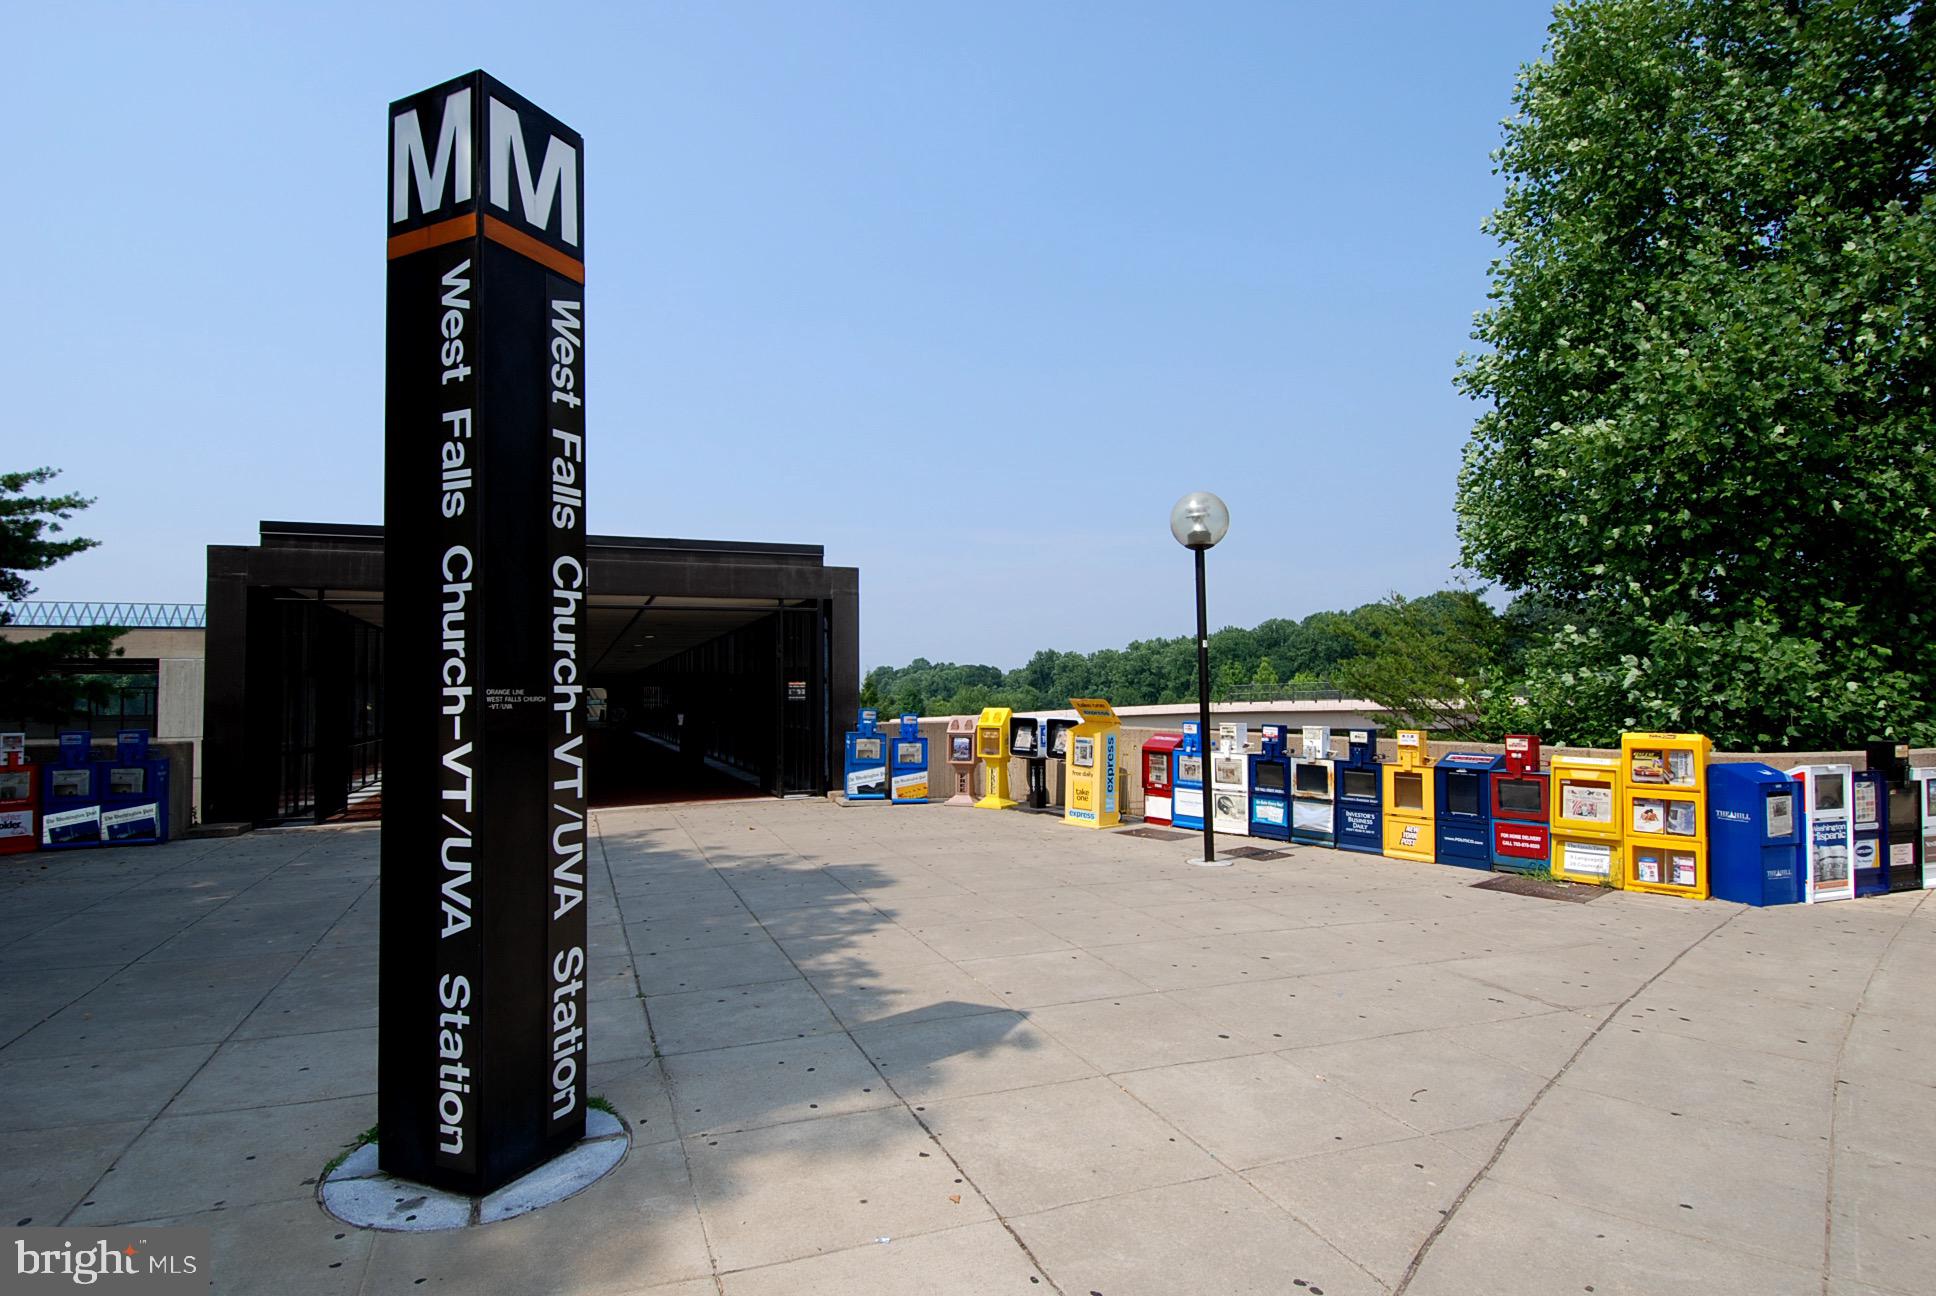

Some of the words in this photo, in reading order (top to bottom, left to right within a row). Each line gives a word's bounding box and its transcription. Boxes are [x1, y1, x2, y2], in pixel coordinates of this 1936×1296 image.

[393, 87, 471, 224] M
[489, 96, 578, 248] M
[440, 258, 472, 386] West
[551, 299, 581, 409] West
[441, 408, 472, 519] Falls
[551, 428, 582, 529] Falls
[485, 688, 511, 696] ORANGE
[512, 688, 525, 696] LINE
[1075, 788, 1089, 796] take
[1106, 736, 1115, 793] express
[1069, 810, 1095, 820] express
[1345, 810, 1375, 820] INVESTOR'S
[1347, 816, 1373, 825] BUSINESS
[1352, 822, 1368, 830] DAILY
[1715, 809, 1729, 817] THE
[1734, 811, 1751, 821] HILL
[438, 973, 471, 1155] Station
[552, 946, 584, 1121] Station
